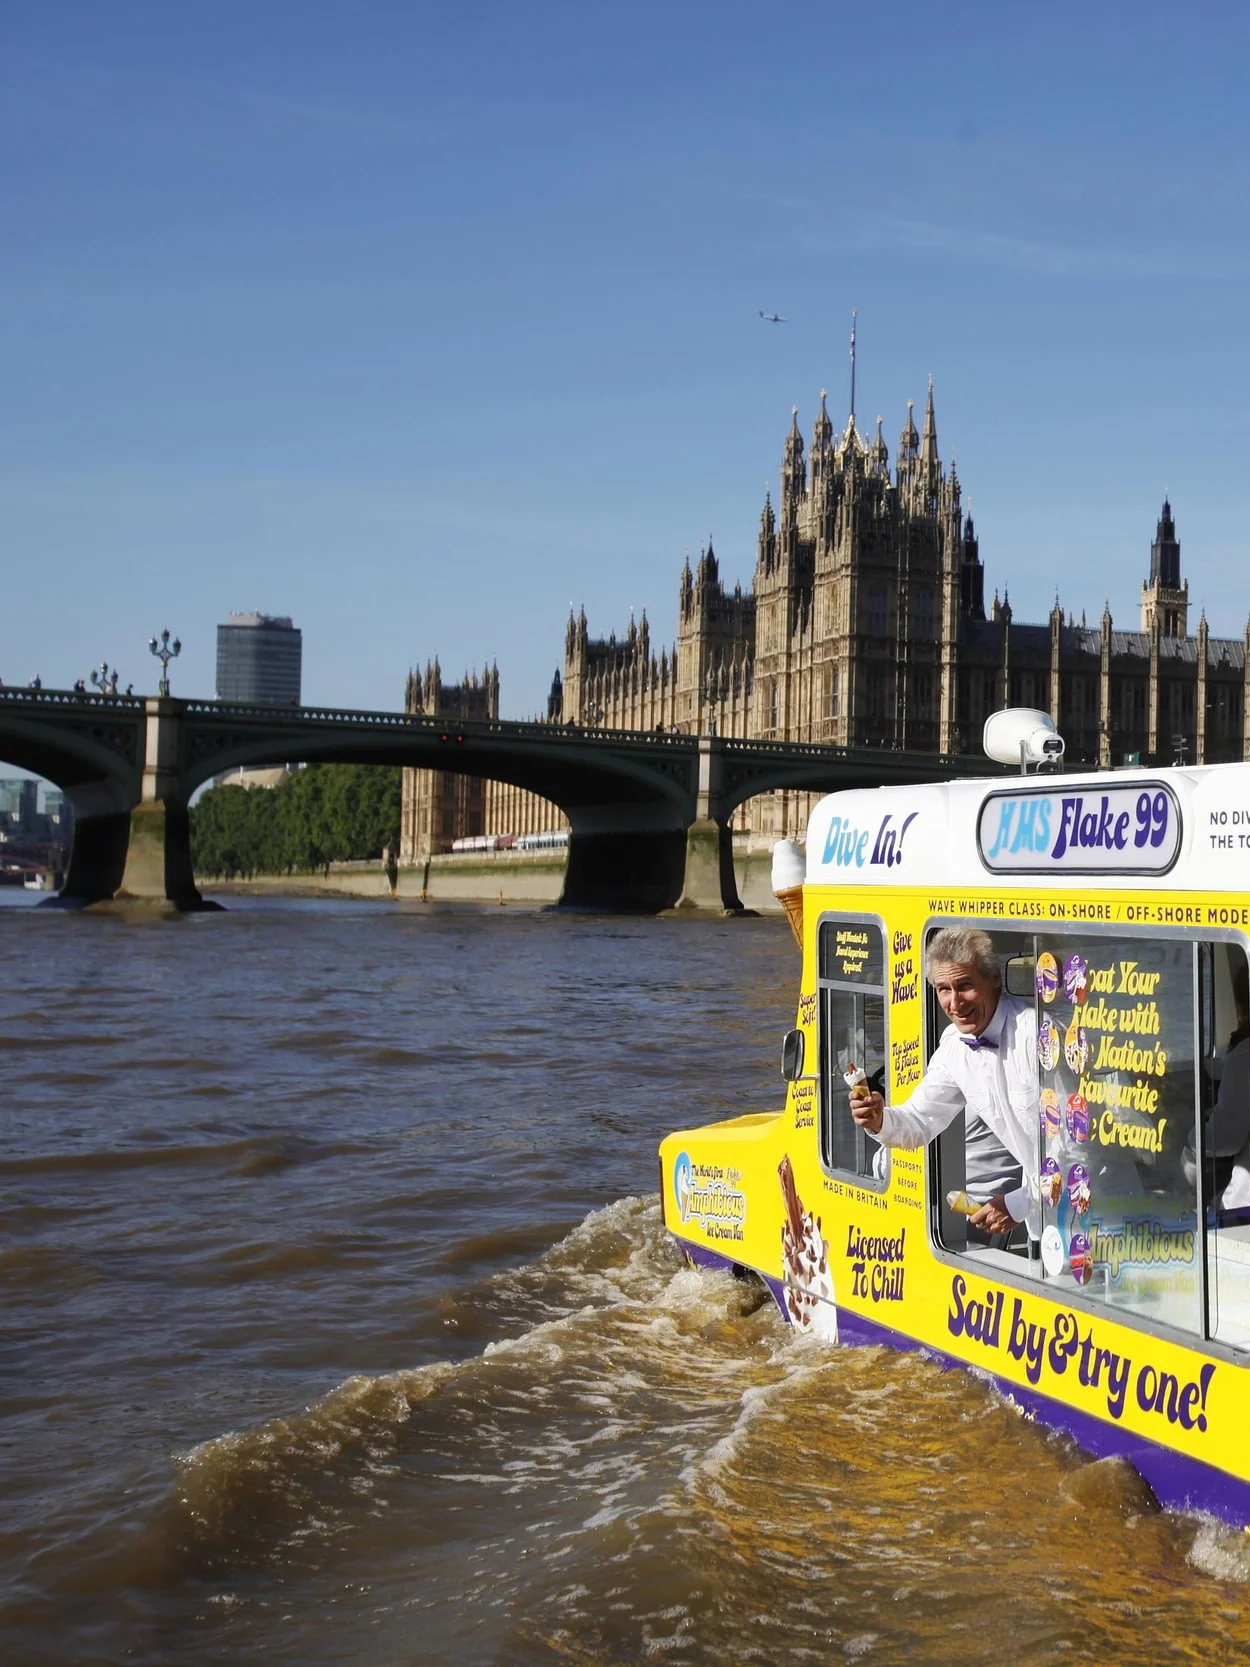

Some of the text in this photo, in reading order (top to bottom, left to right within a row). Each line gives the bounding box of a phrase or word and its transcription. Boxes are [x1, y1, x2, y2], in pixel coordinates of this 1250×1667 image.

[987, 791, 1168, 860] HMS Flake 99
[1209, 811, 1228, 826] NO
[821, 812, 919, 868] Dive In!
[1209, 834, 1234, 849] THE
[928, 899, 955, 913] WAVE
[958, 901, 1005, 915] WHIPPER
[1009, 902, 1046, 917] CLASS:
[1049, 903, 1112, 919] ON-SHORE
[1126, 905, 1202, 923] OFF-SHORE
[893, 930, 913, 956] Give
[894, 958, 913, 979] us a
[1116, 961, 1160, 996] Your
[891, 974, 919, 1005] Wave!
[1119, 1001, 1160, 1035] with
[1093, 1036, 1167, 1077] Nation's
[795, 1114, 814, 1129] Service
[1098, 1110, 1168, 1153] Cream!
[892, 1158, 922, 1174] PASSPORTS
[823, 1180, 888, 1211] MADE IN BRITAIN
[897, 1177, 918, 1190] BEFORE
[893, 1193, 922, 1210] BOARDING
[714, 1223, 733, 1240] Cream
[846, 1225, 906, 1263] Licensed
[852, 1262, 905, 1303] To Chill
[948, 1274, 1005, 1348] Sail
[1007, 1297, 1047, 1385] by
[1048, 1313, 1080, 1375] &
[1078, 1328, 1132, 1420] try
[1136, 1363, 1217, 1433] one!
